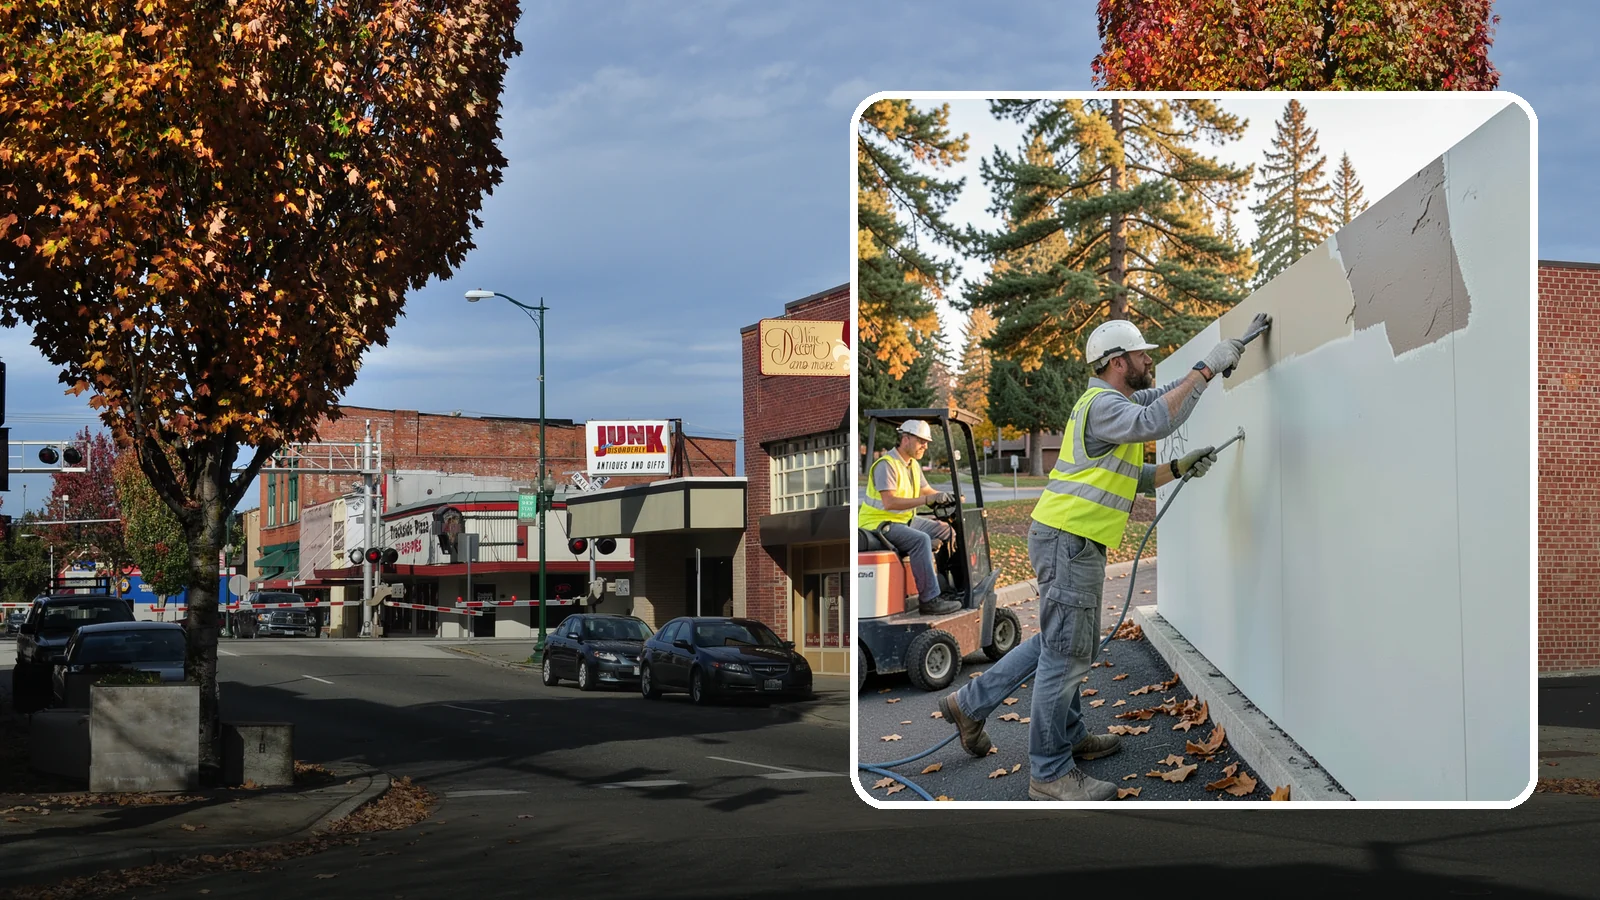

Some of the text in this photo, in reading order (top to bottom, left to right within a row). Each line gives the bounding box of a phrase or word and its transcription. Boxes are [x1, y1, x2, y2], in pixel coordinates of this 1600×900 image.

[765, 328, 831, 365] Decor
[596, 426, 665, 457] JUNK
[597, 460, 665, 470] ANTIQUES AND GIFTS
[390, 519, 429, 540] Trackside Pizza
